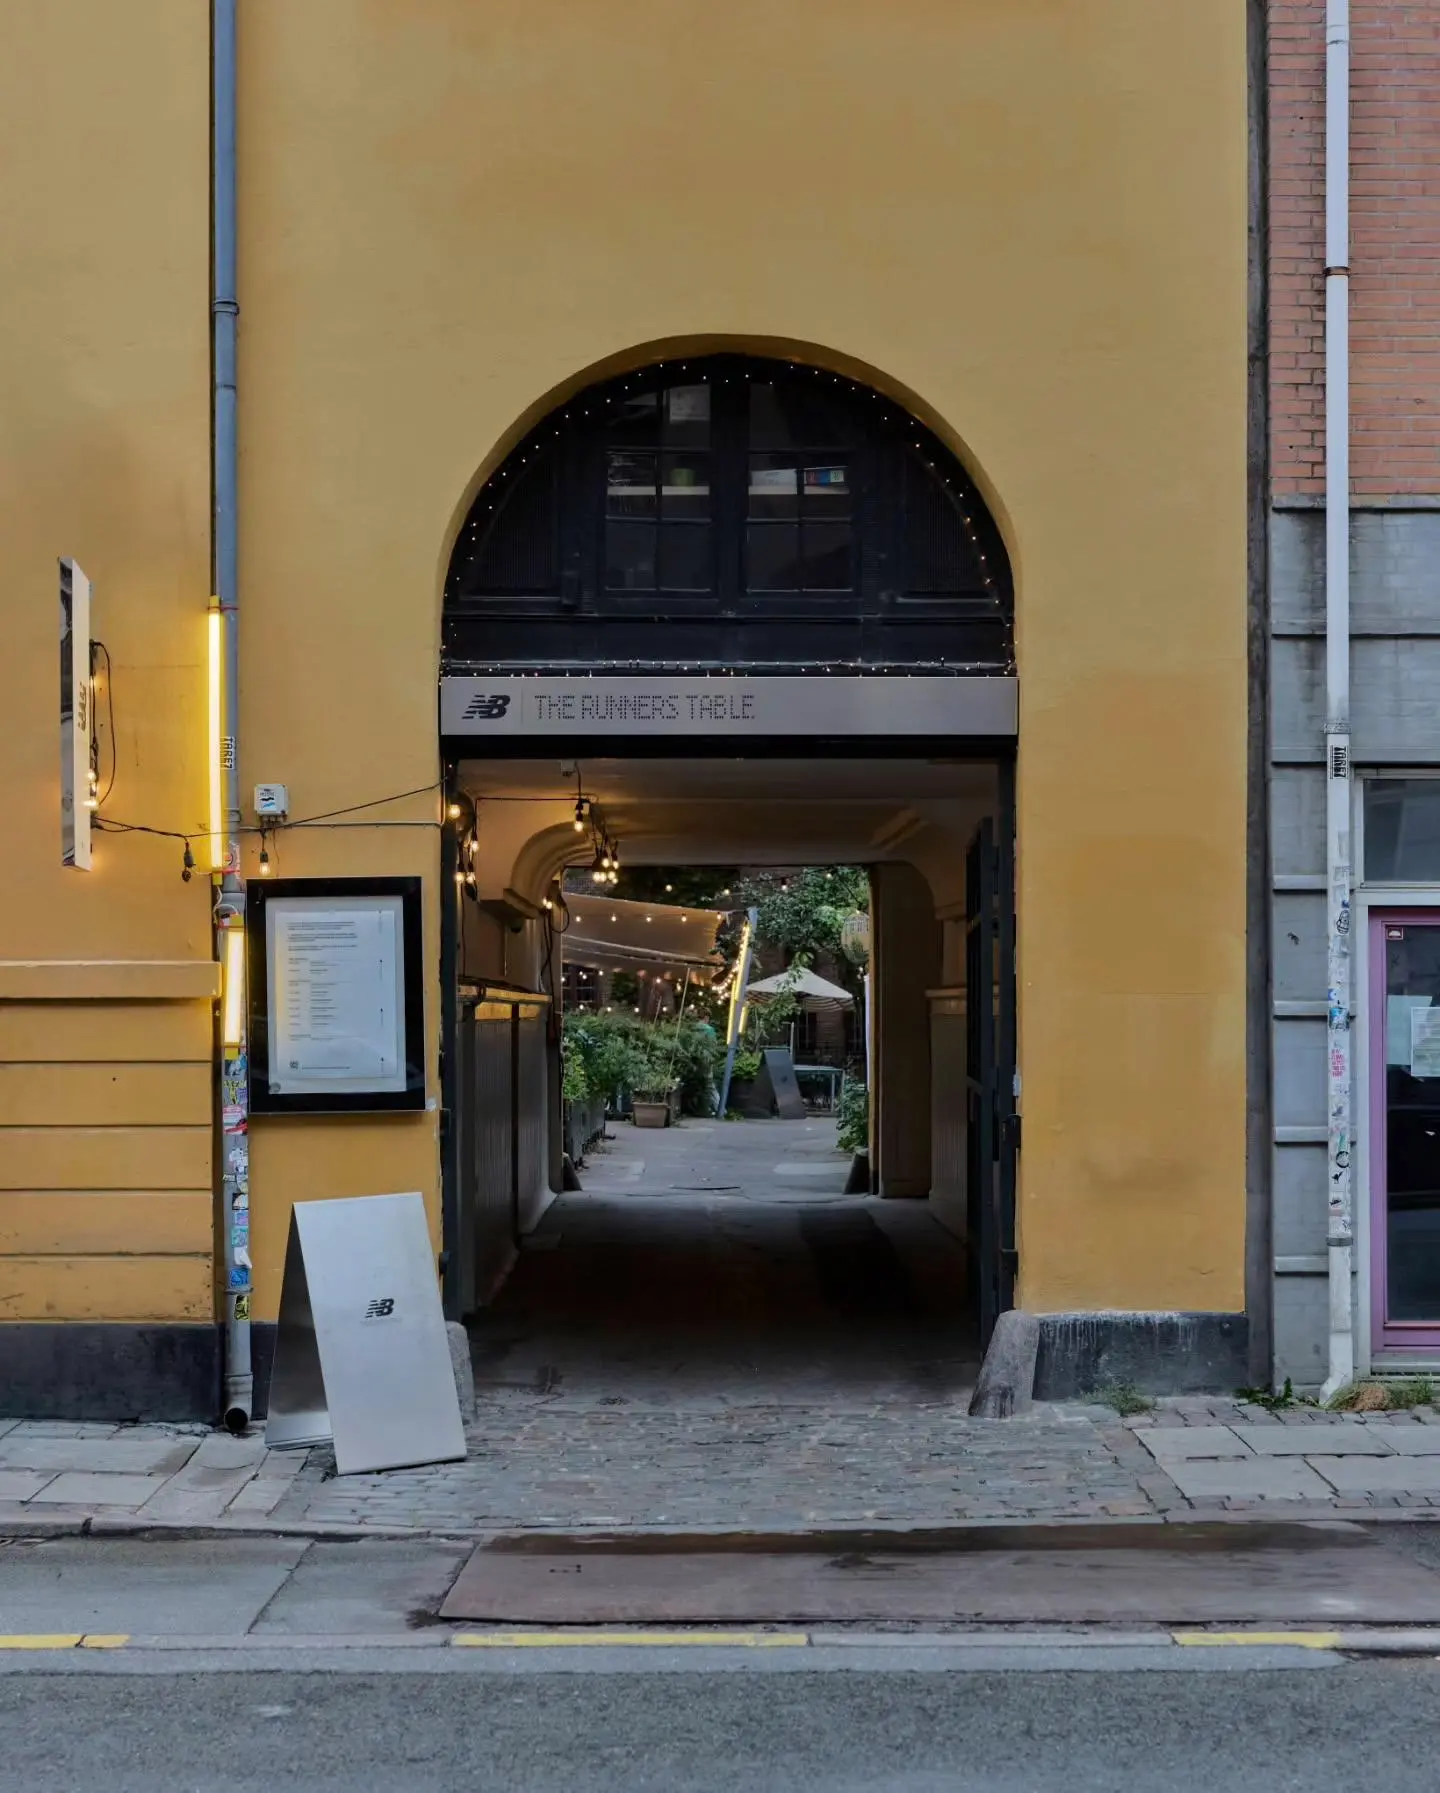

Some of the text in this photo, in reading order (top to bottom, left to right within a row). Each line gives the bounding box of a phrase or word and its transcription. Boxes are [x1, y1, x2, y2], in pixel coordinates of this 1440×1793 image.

[534, 695, 755, 720] THE RUNNERS TABLE
